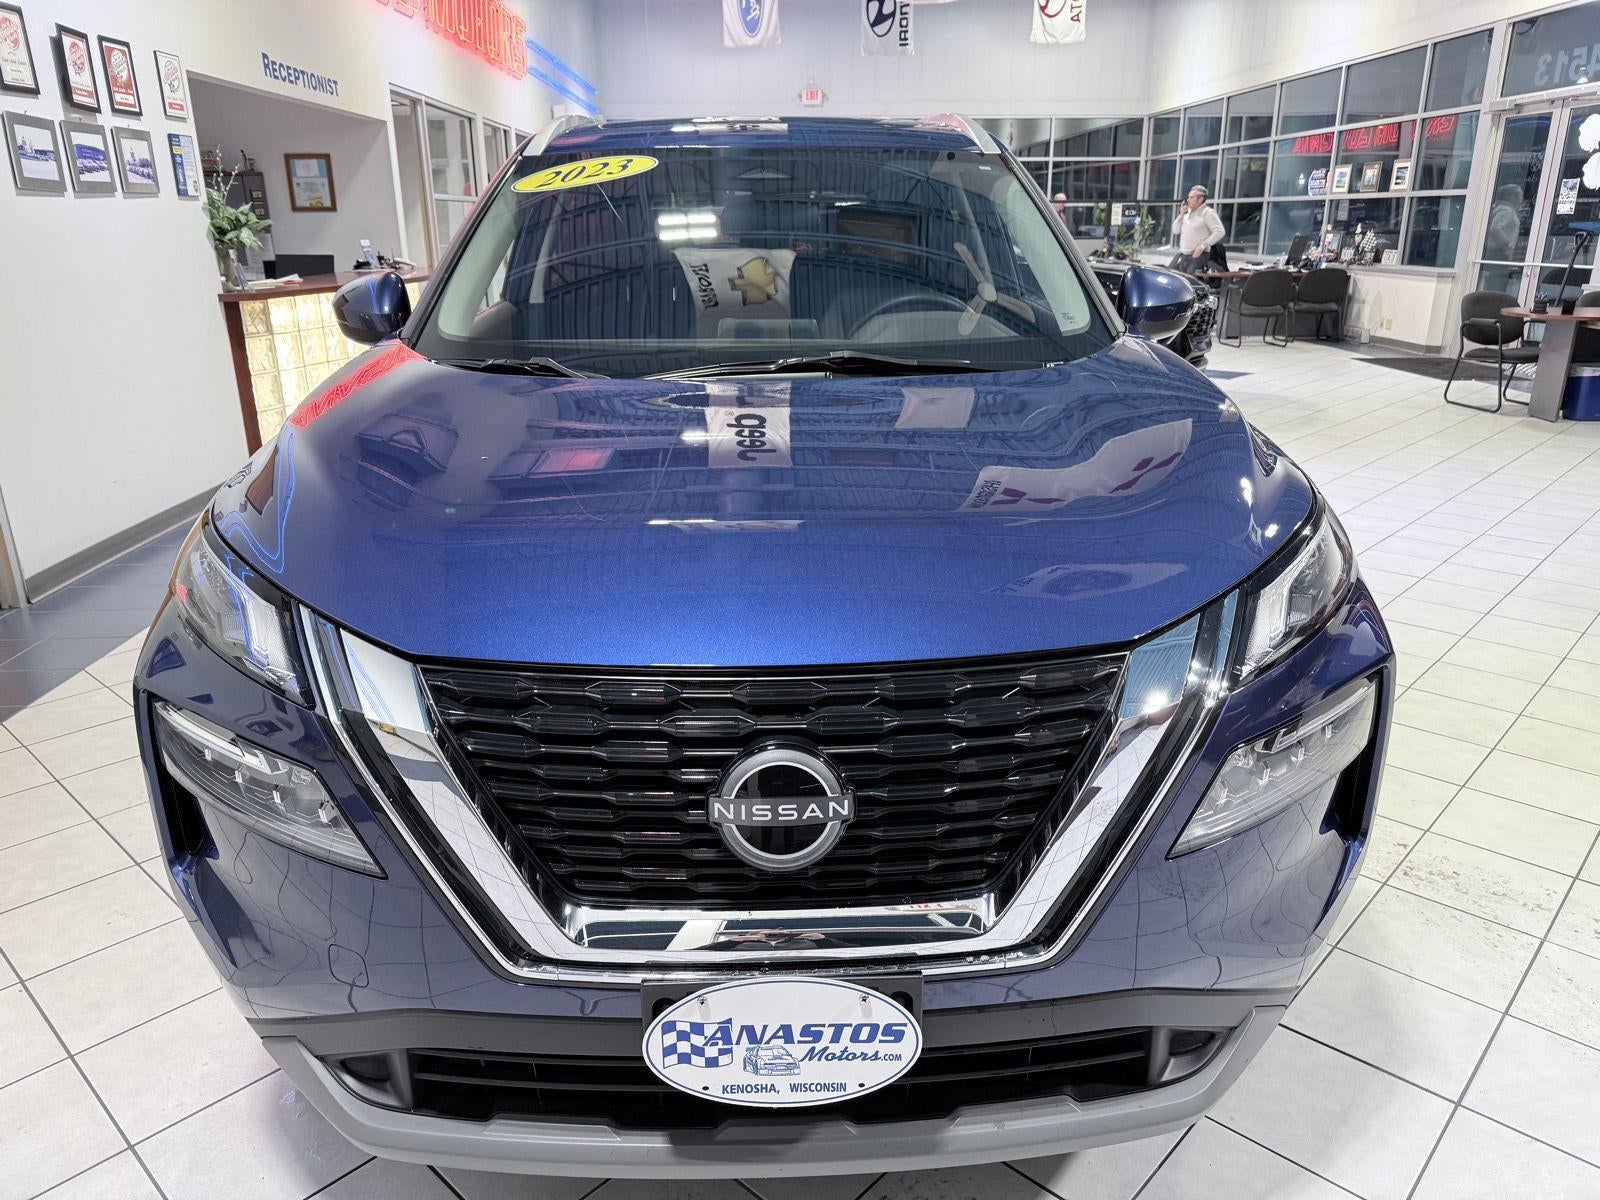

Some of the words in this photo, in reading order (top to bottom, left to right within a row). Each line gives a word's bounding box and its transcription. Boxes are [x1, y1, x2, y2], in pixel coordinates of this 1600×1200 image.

[261, 51, 339, 97] RECEPTIONIST
[806, 89, 819, 101] EXIT
[535, 158, 634, 189] 2023
[713, 799, 849, 821] NISSAN
[702, 1022, 908, 1046] ANASTOS
[721, 1082, 781, 1095] KENOSHA,
[789, 1081, 848, 1093] WISCONSIN
